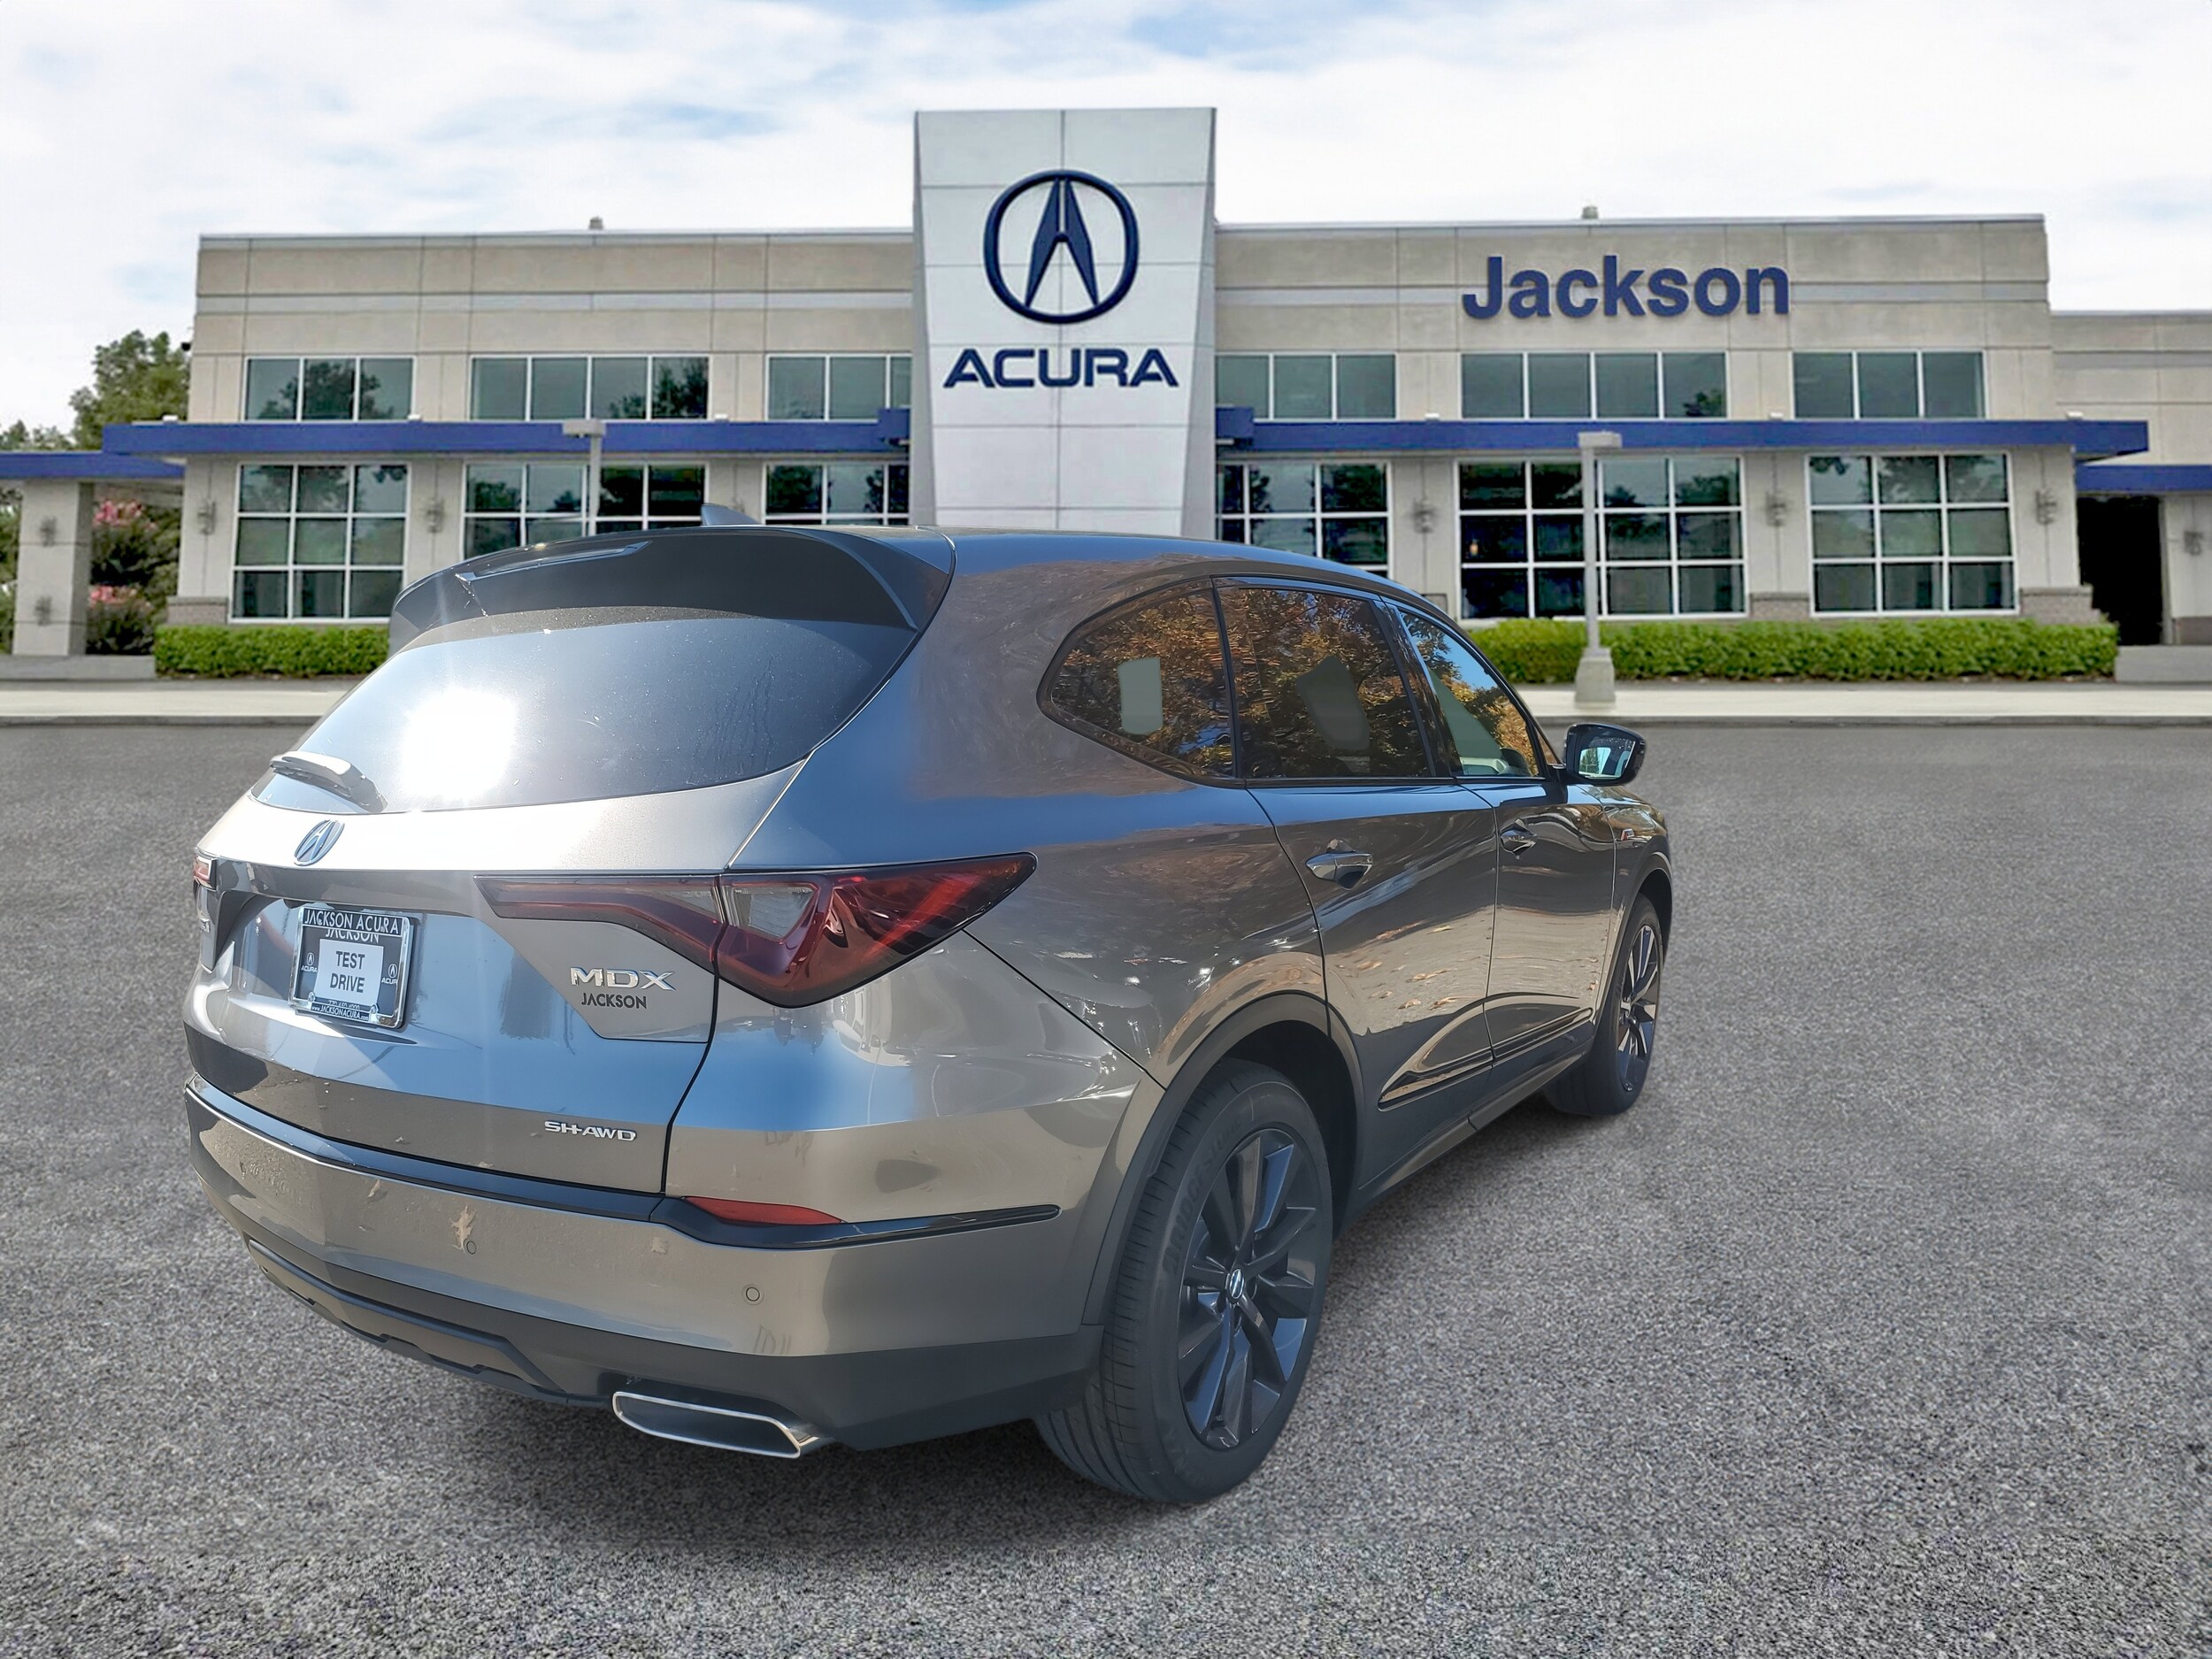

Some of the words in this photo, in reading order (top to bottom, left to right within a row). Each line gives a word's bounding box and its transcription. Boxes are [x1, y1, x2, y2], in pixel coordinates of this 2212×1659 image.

[1463, 255, 1789, 319] Jackson
[942, 348, 1179, 388] ACURA
[304, 910, 353, 928] JACKSON
[356, 916, 399, 934] ACURA
[335, 950, 365, 970] TEST
[329, 972, 365, 993] DRIVE
[570, 967, 676, 991] MDX
[580, 992, 648, 1010] JACKSON
